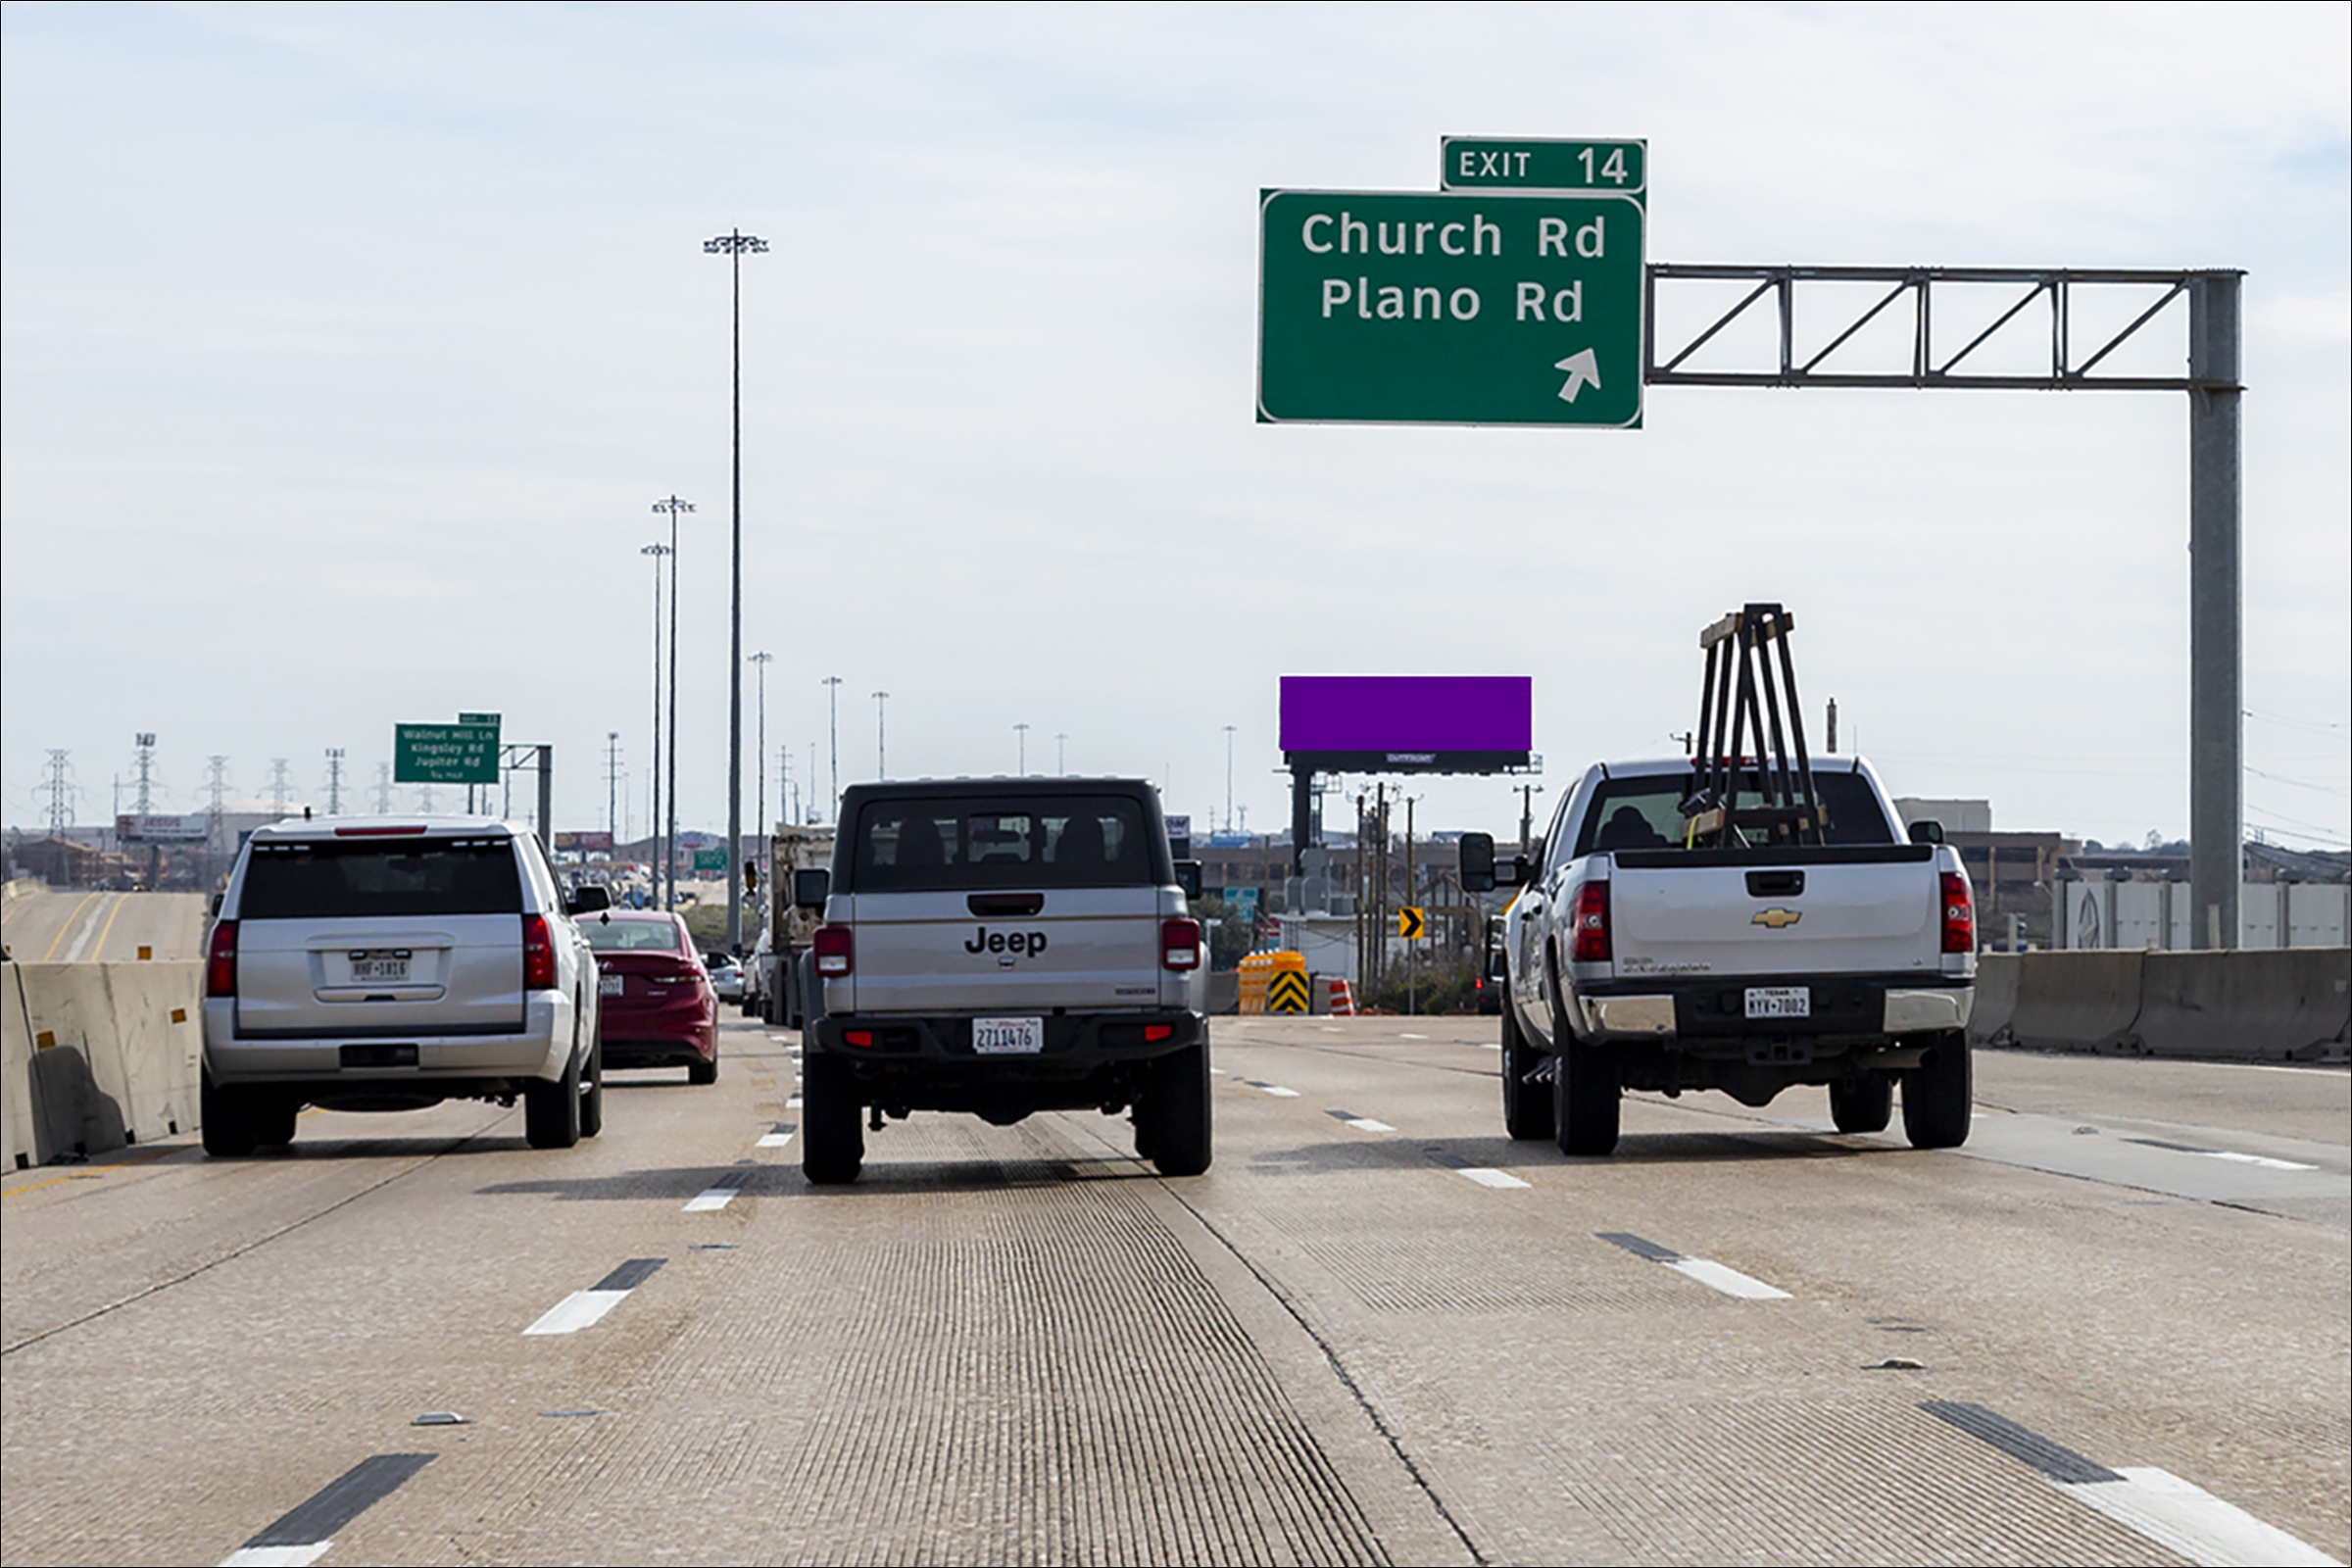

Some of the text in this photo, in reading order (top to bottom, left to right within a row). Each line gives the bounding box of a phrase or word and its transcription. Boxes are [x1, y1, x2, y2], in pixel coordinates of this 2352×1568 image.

[1459, 147, 1628, 184] EXIT 14
[1301, 212, 1605, 258] Church Rd
[1321, 277, 1583, 322] Plano Rd
[403, 729, 494, 741] Walnut Hill Ln
[411, 744, 484, 756] Kingsley Rd
[415, 757, 480, 768] Jupiter Rd
[964, 926, 1048, 957] Jeep
[976, 1027, 1033, 1048] 2711476
